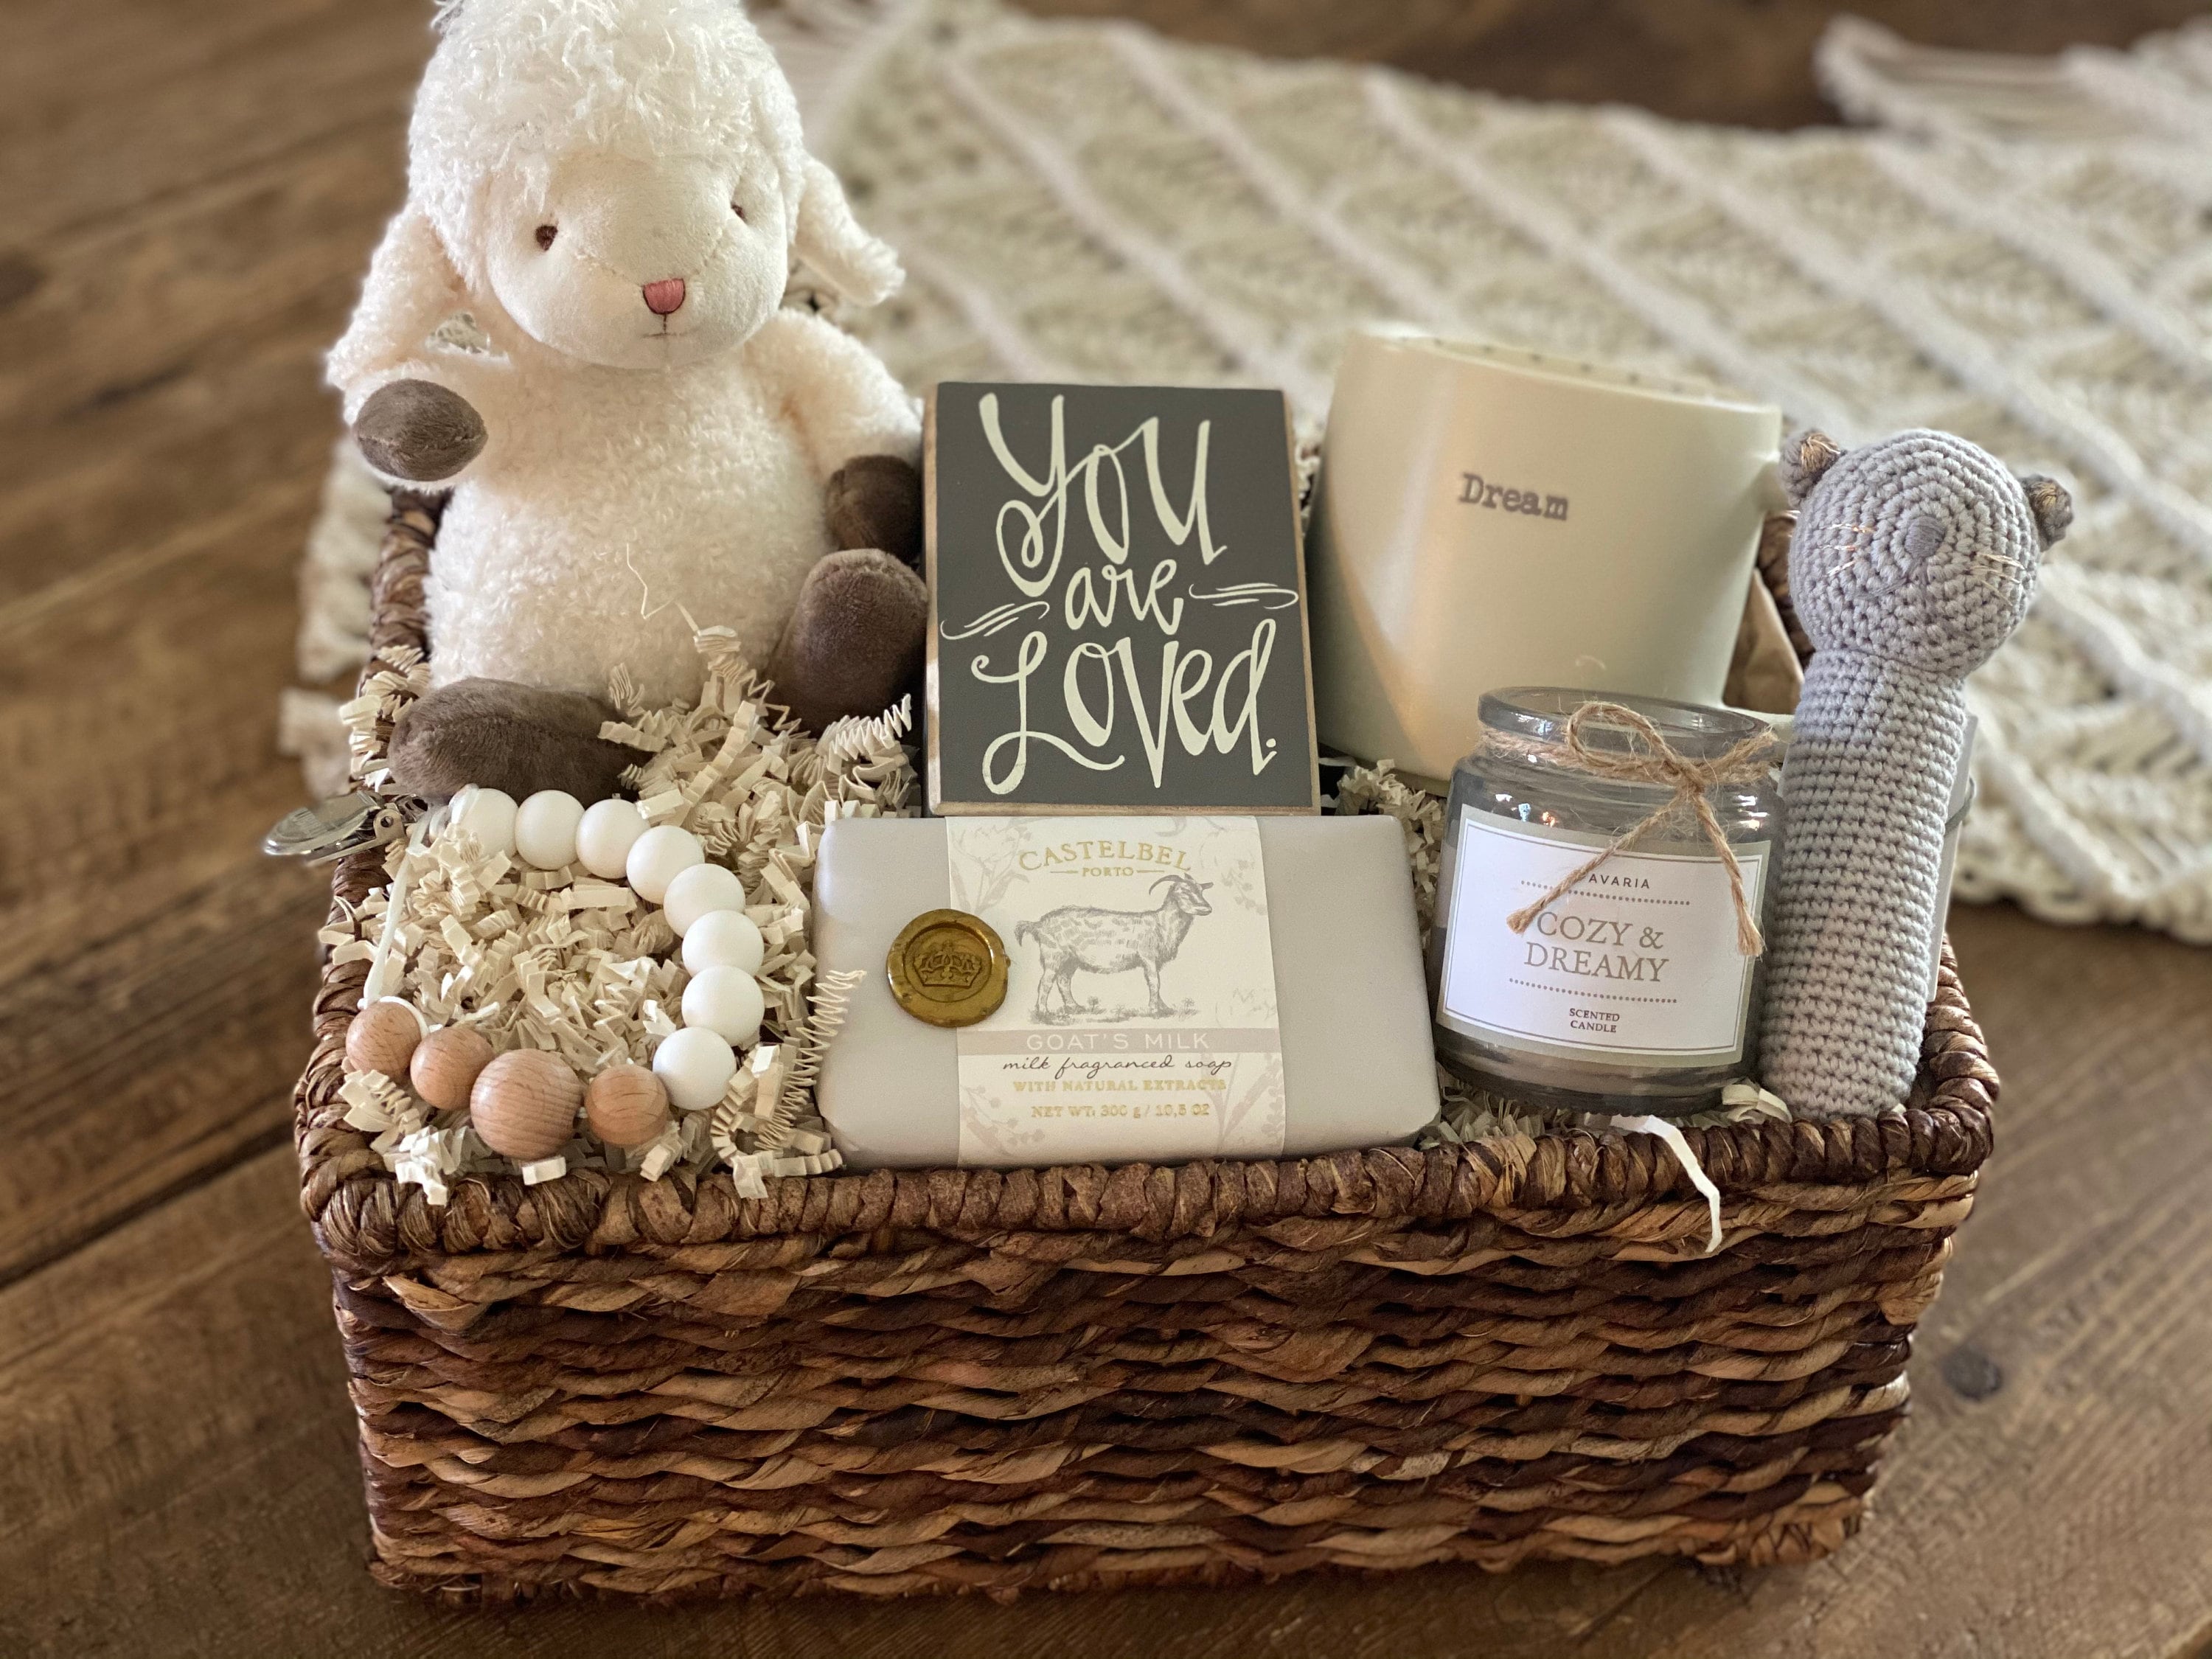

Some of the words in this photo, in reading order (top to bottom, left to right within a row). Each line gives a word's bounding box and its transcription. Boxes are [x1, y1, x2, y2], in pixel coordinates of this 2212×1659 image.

[1459, 471, 1568, 521] Dream
[1065, 560, 1183, 635] are
[1019, 840, 1191, 872] CASTELBEL
[1082, 866, 1134, 877] PORTO
[1588, 873, 1650, 889] AVARIA
[1537, 911, 1633, 946] COZY
[1639, 926, 1664, 950] &
[1523, 941, 1670, 982] DREAMY
[1568, 1007, 1621, 1022] SCENTED
[1570, 1020, 1618, 1033] CANDLE
[1026, 1033, 1129, 1051] GOAT'S
[1145, 1032, 1210, 1050] MILK
[1003, 1056, 1051, 1070] milk
[1054, 1054, 1175, 1080] fragranced
[1185, 1060, 1232, 1077] soap
[1013, 1081, 1057, 1091] WITH
[1062, 1080, 1138, 1091] NATURAL
[1143, 1079, 1227, 1091] EXTRACTS
[1031, 1105, 1062, 1117] NET
[1100, 1104, 1127, 1116] 300
[1191, 1103, 1210, 1116] OZ
